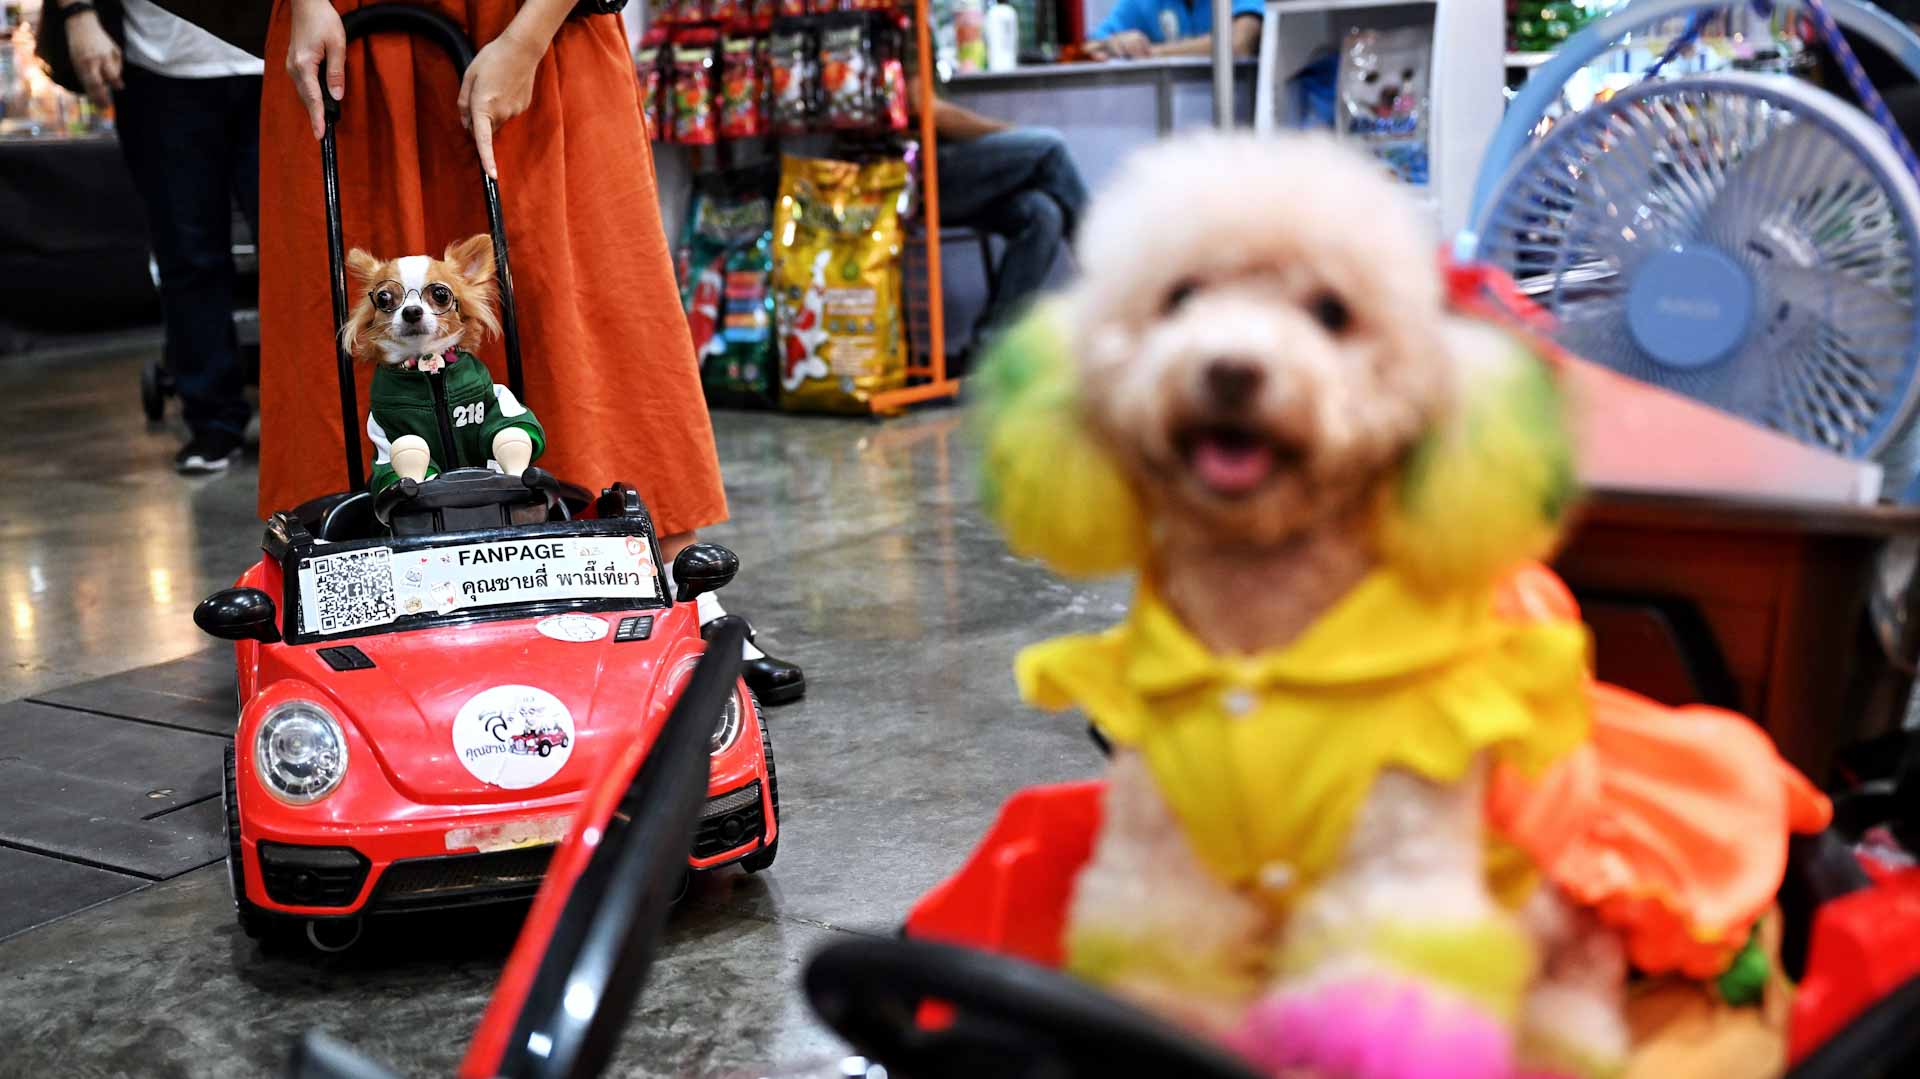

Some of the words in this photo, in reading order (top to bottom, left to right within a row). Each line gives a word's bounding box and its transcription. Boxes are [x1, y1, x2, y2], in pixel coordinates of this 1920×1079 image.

[453, 401, 485, 428] 218
[458, 543, 566, 566] FANPAGE
[462, 563, 549, 602] คุณชายสี่
